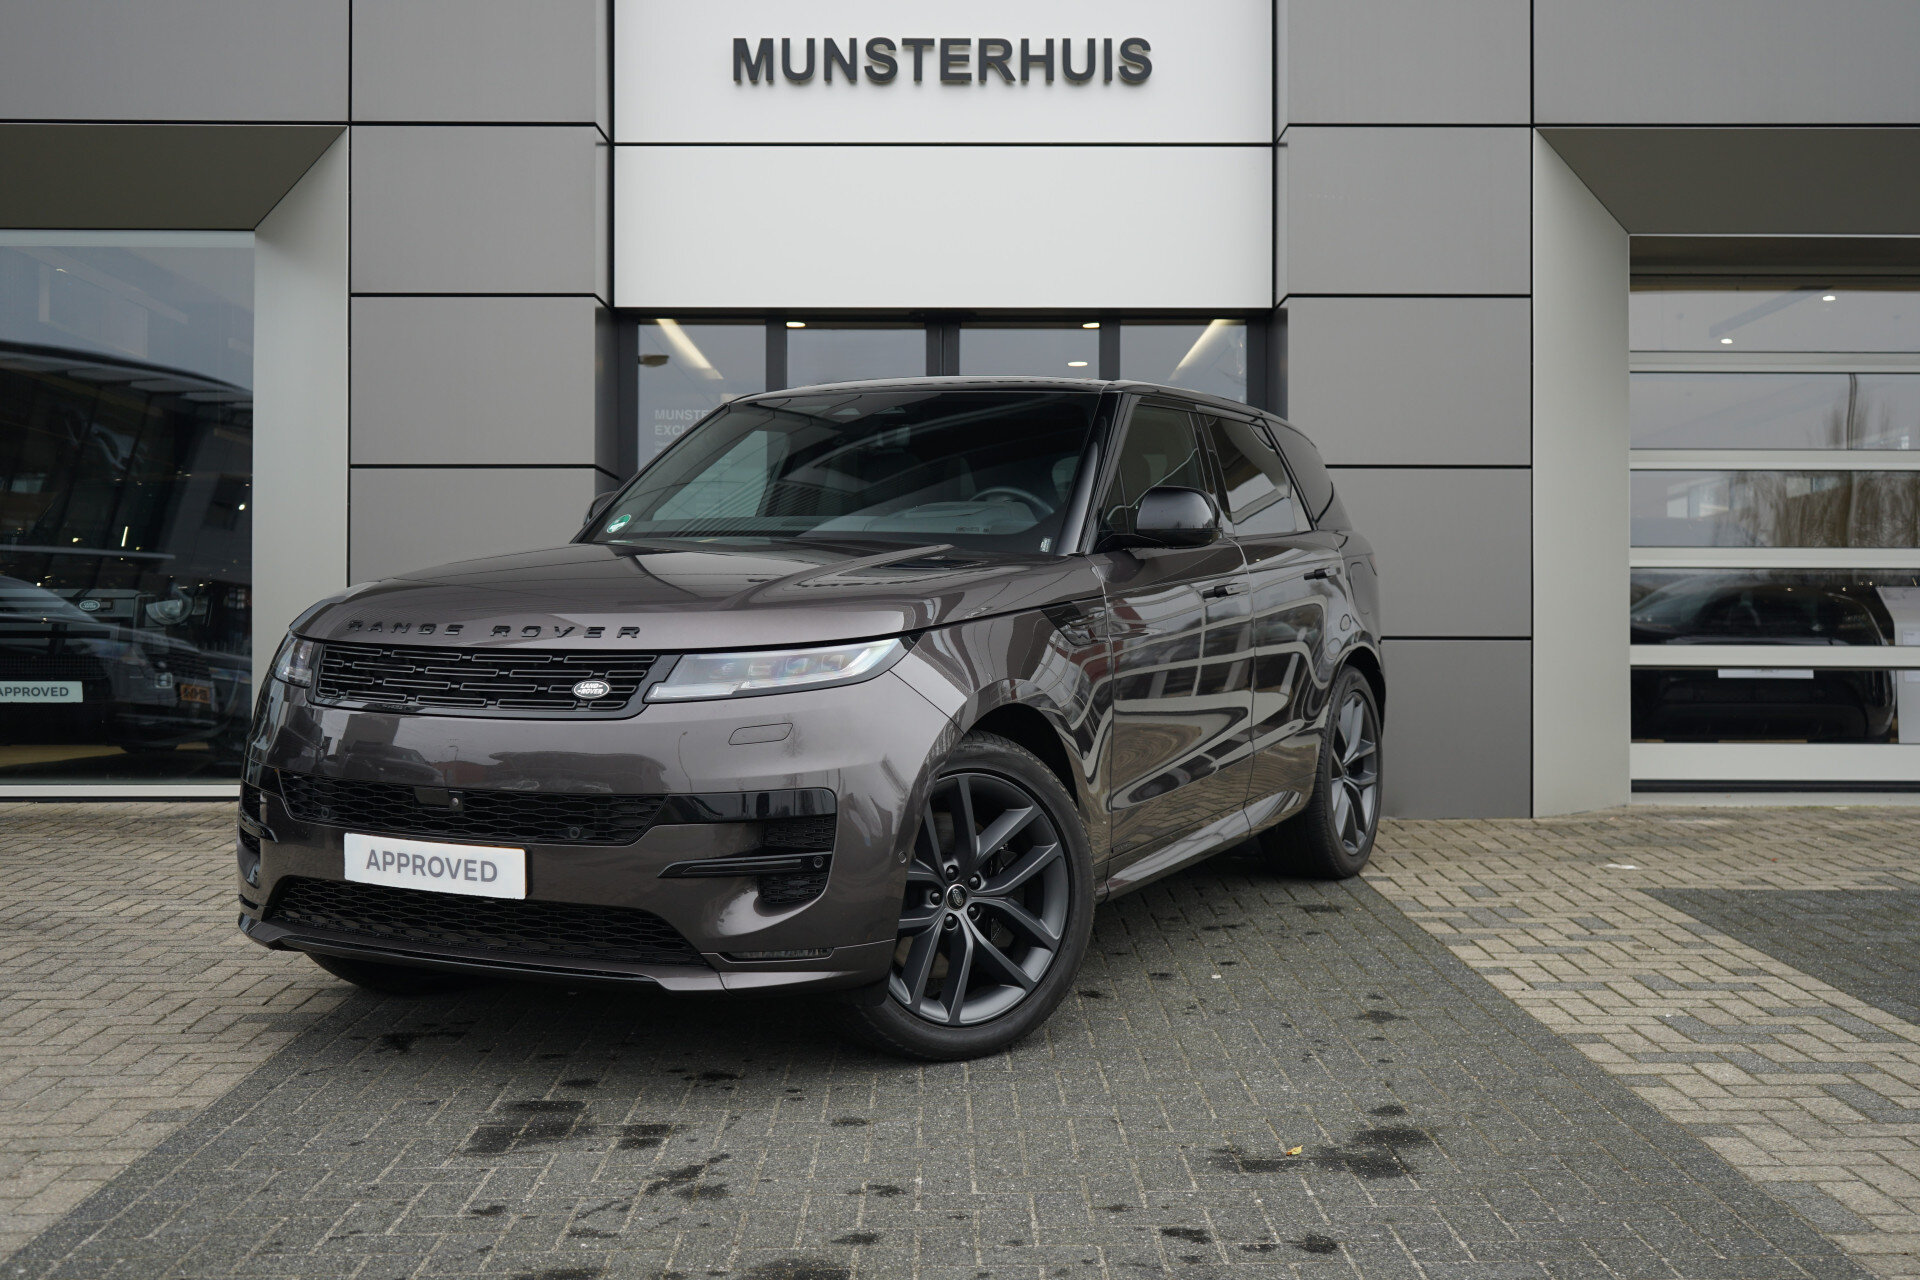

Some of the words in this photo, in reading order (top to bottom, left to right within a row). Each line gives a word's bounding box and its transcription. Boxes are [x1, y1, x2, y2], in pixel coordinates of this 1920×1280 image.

[733, 37, 1153, 84] MUNSTERHUIS
[346, 620, 464, 636] RANGE
[490, 625, 641, 639] ROVER
[366, 849, 498, 883] APPROVED
